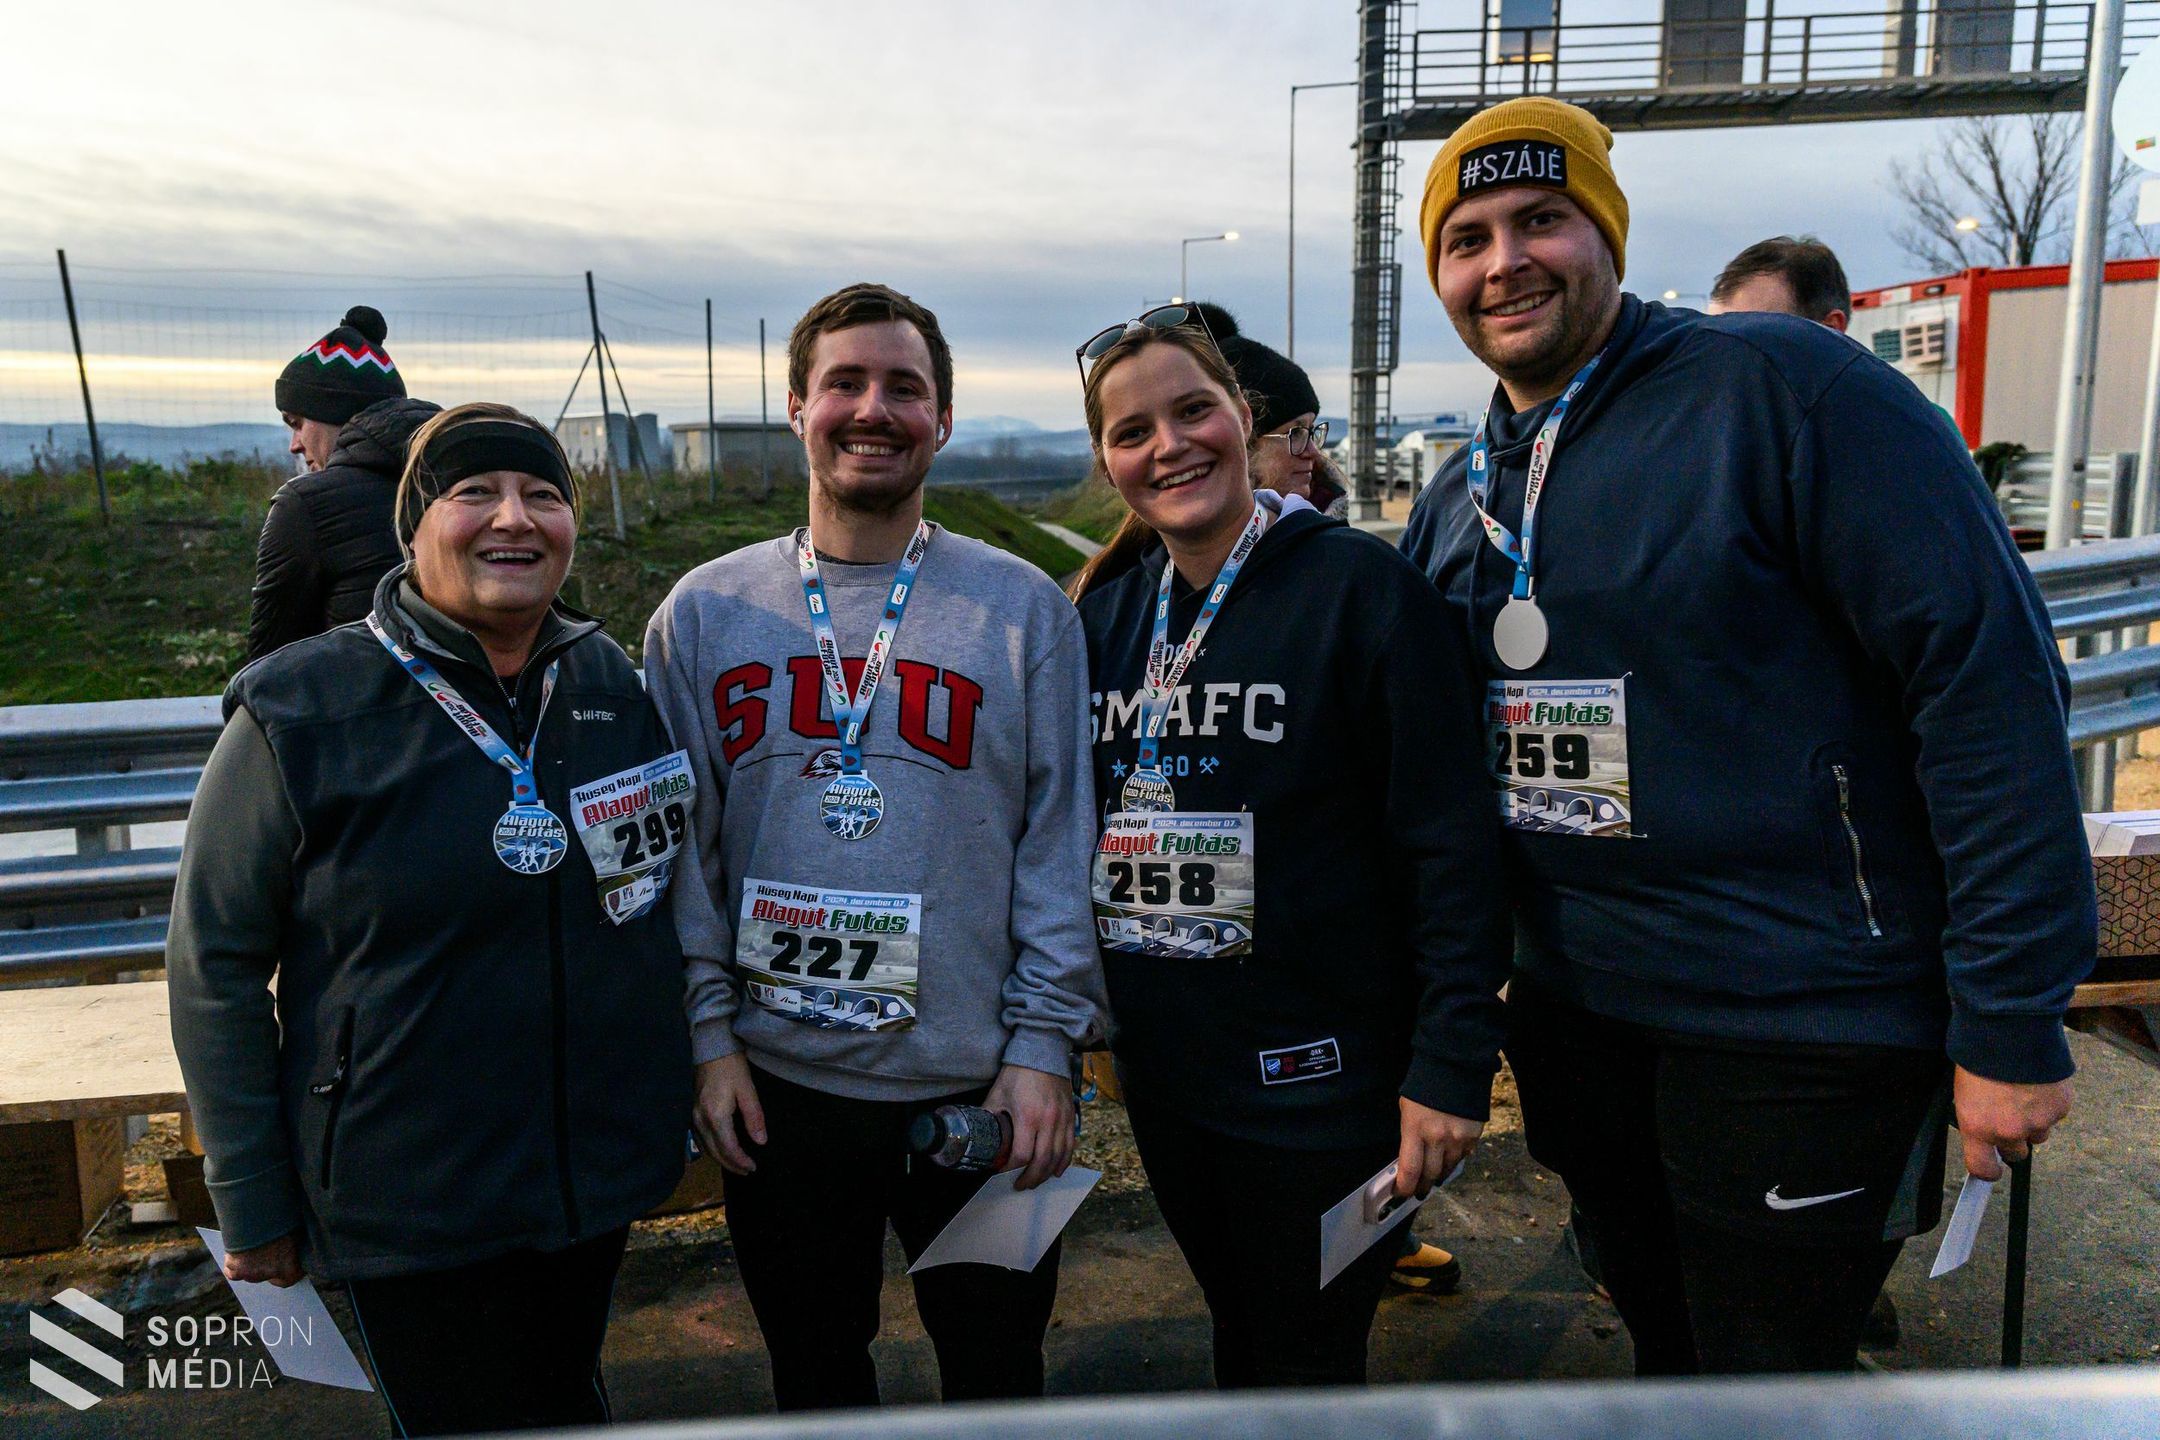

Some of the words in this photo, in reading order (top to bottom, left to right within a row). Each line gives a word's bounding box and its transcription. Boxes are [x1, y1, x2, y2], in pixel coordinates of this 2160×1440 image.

[1462, 144, 1562, 188] #SZÁJÉ
[1507, 686, 1523, 698] Napi
[583, 710, 613, 721] HI-TEC
[713, 655, 983, 770] SUU
[1535, 701, 1612, 724] Futás
[1495, 731, 1591, 780] 259
[616, 771, 642, 790] Napi
[582, 784, 650, 828] Alagút
[650, 772, 690, 804] Futás
[613, 802, 687, 870] 299
[1123, 818, 1148, 830] Napi
[1179, 819, 1221, 828] december
[1160, 832, 1241, 854] Futás
[792, 889, 819, 904] Napi
[850, 897, 893, 907] december
[1107, 861, 1215, 906] 258
[752, 898, 826, 928] Alagút
[828, 908, 910, 933] Futás
[769, 931, 879, 981] 227
